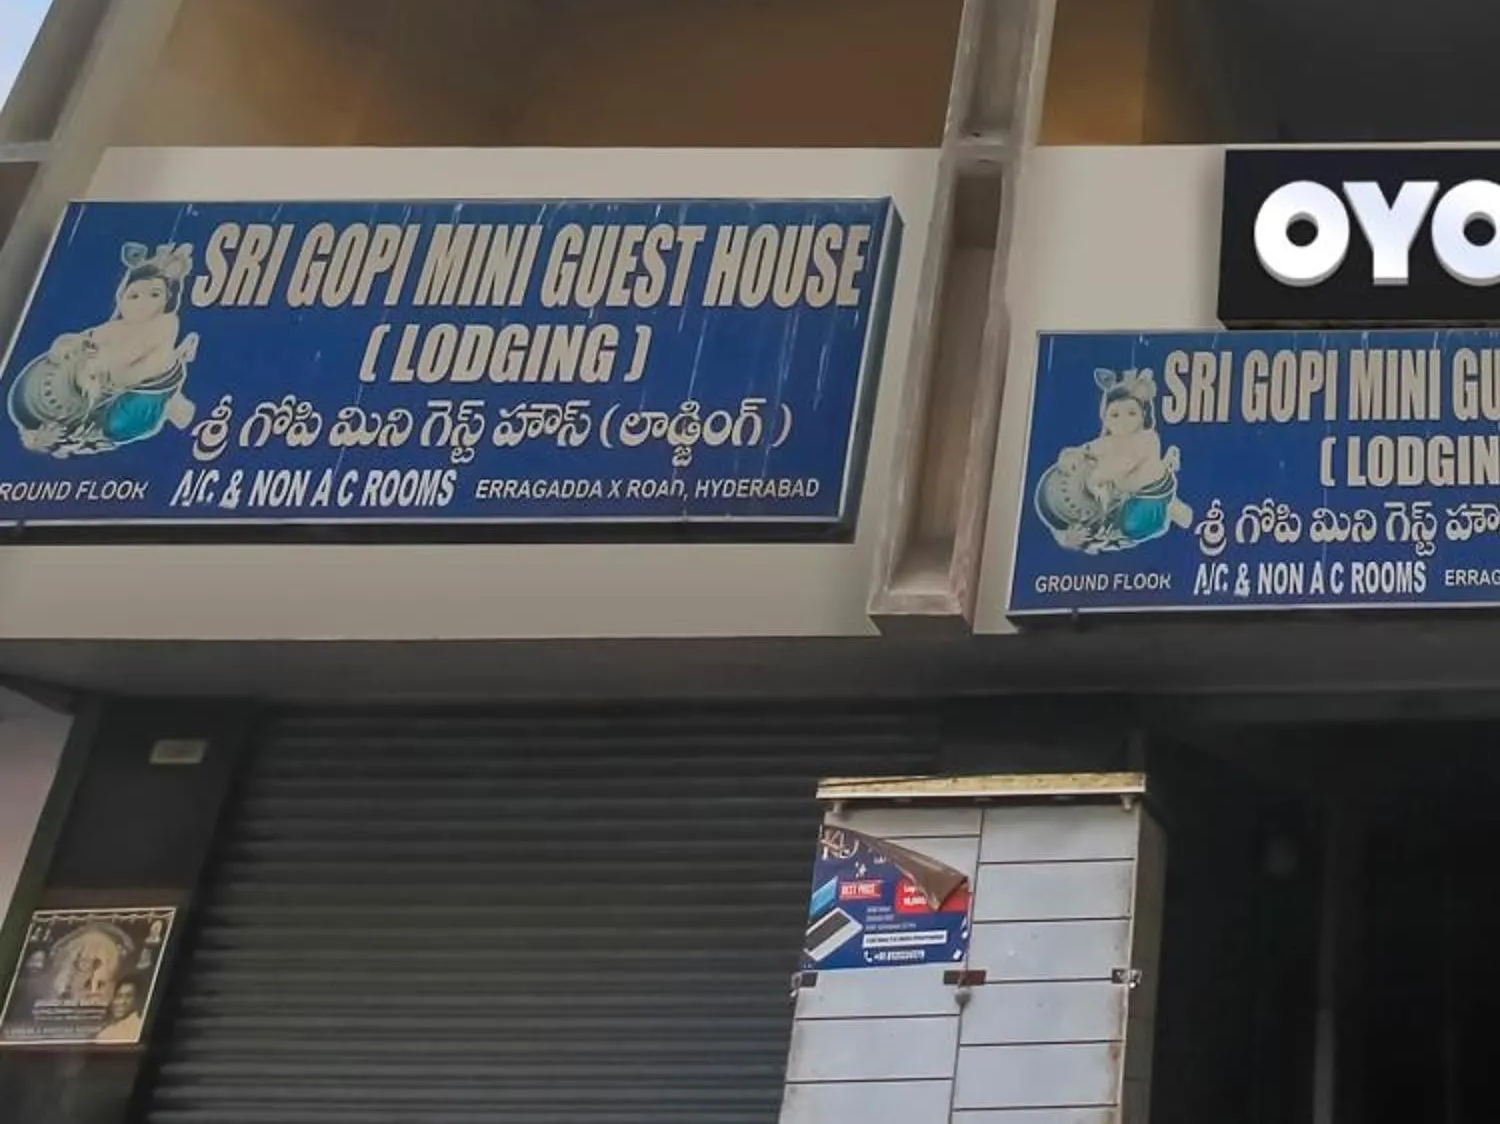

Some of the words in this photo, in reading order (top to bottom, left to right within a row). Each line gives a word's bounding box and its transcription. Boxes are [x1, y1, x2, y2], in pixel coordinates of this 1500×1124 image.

[190, 222, 295, 308] SRI
[286, 222, 421, 308] GOPI
[412, 223, 543, 307] MINI
[540, 223, 706, 308] GUEST
[702, 223, 871, 308] HOUSE
[1162, 349, 1233, 424] SRI
[1241, 348, 1338, 423] GOPI
[1349, 347, 1440, 422] MINI
[191, 394, 233, 462] శ్రీ
[240, 394, 323, 447] గోపి
[328, 406, 414, 447] మిని
[169, 469, 220, 507] A/C
[217, 469, 244, 509] &
[248, 469, 313, 508] NON
[360, 469, 457, 508] ROOMS
[475, 478, 602, 499] ERRAGADDA
[607, 479, 621, 499] X
[626, 480, 689, 501] ROAD,
[694, 478, 821, 499] HYDERABAD
[1195, 498, 1228, 557] శ్రీ
[1236, 497, 1302, 543] గోపి
[1309, 506, 1377, 543] మిని
[1035, 574, 1109, 593] GROUND
[1194, 563, 1229, 595] A/C
[1233, 563, 1250, 597] &
[1257, 562, 1305, 595] NON
[1351, 560, 1427, 594] ROOMS
